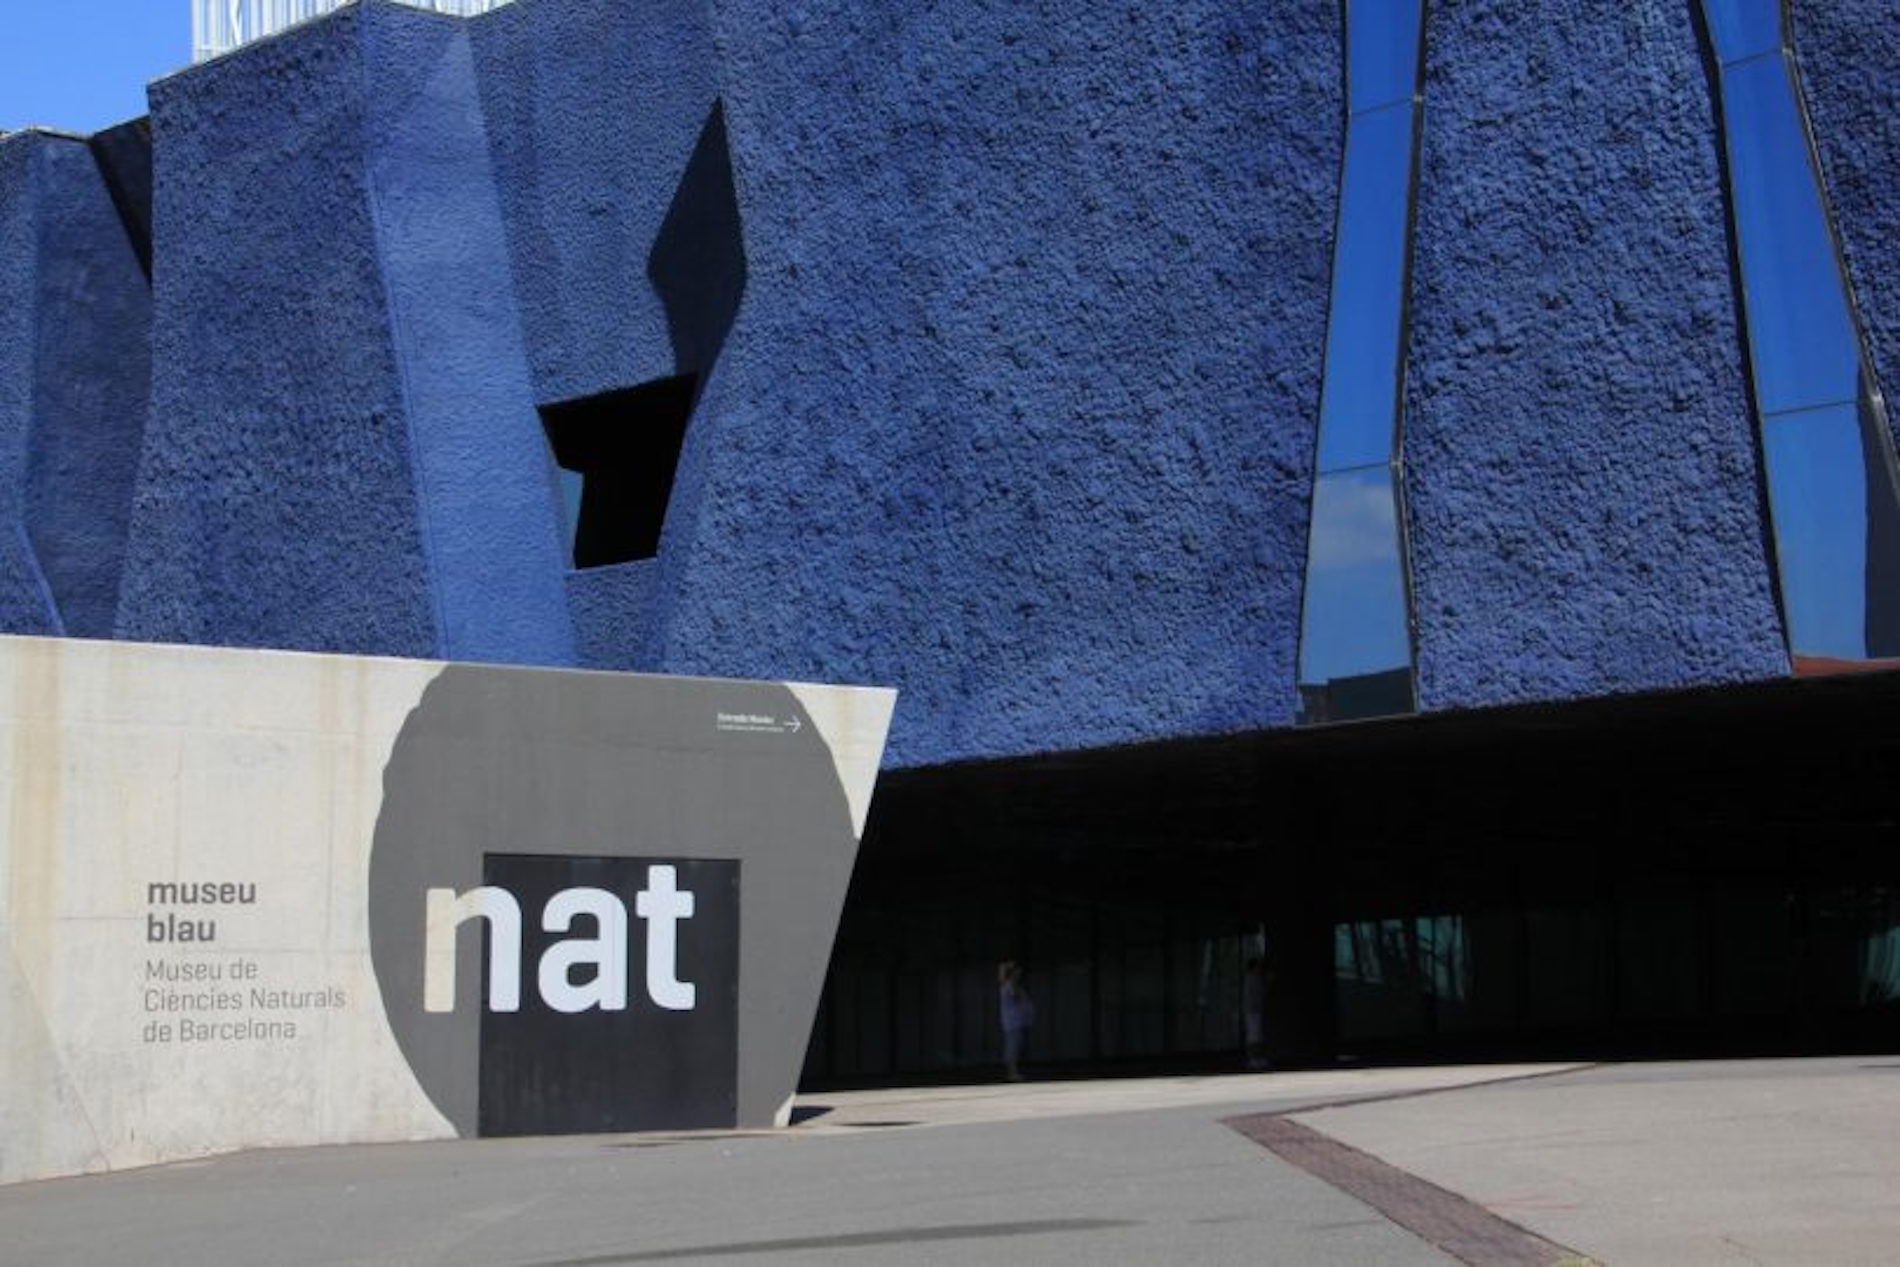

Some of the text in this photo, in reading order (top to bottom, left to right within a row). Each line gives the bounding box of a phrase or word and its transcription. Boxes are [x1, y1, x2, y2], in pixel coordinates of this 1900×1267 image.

[148, 882, 256, 904] museu
[147, 913, 216, 942] blau
[424, 865, 696, 1013] nat
[145, 957, 258, 981] Museu de
[250, 987, 346, 1009] Naturals
[143, 1018, 297, 1043] de Barcelona
